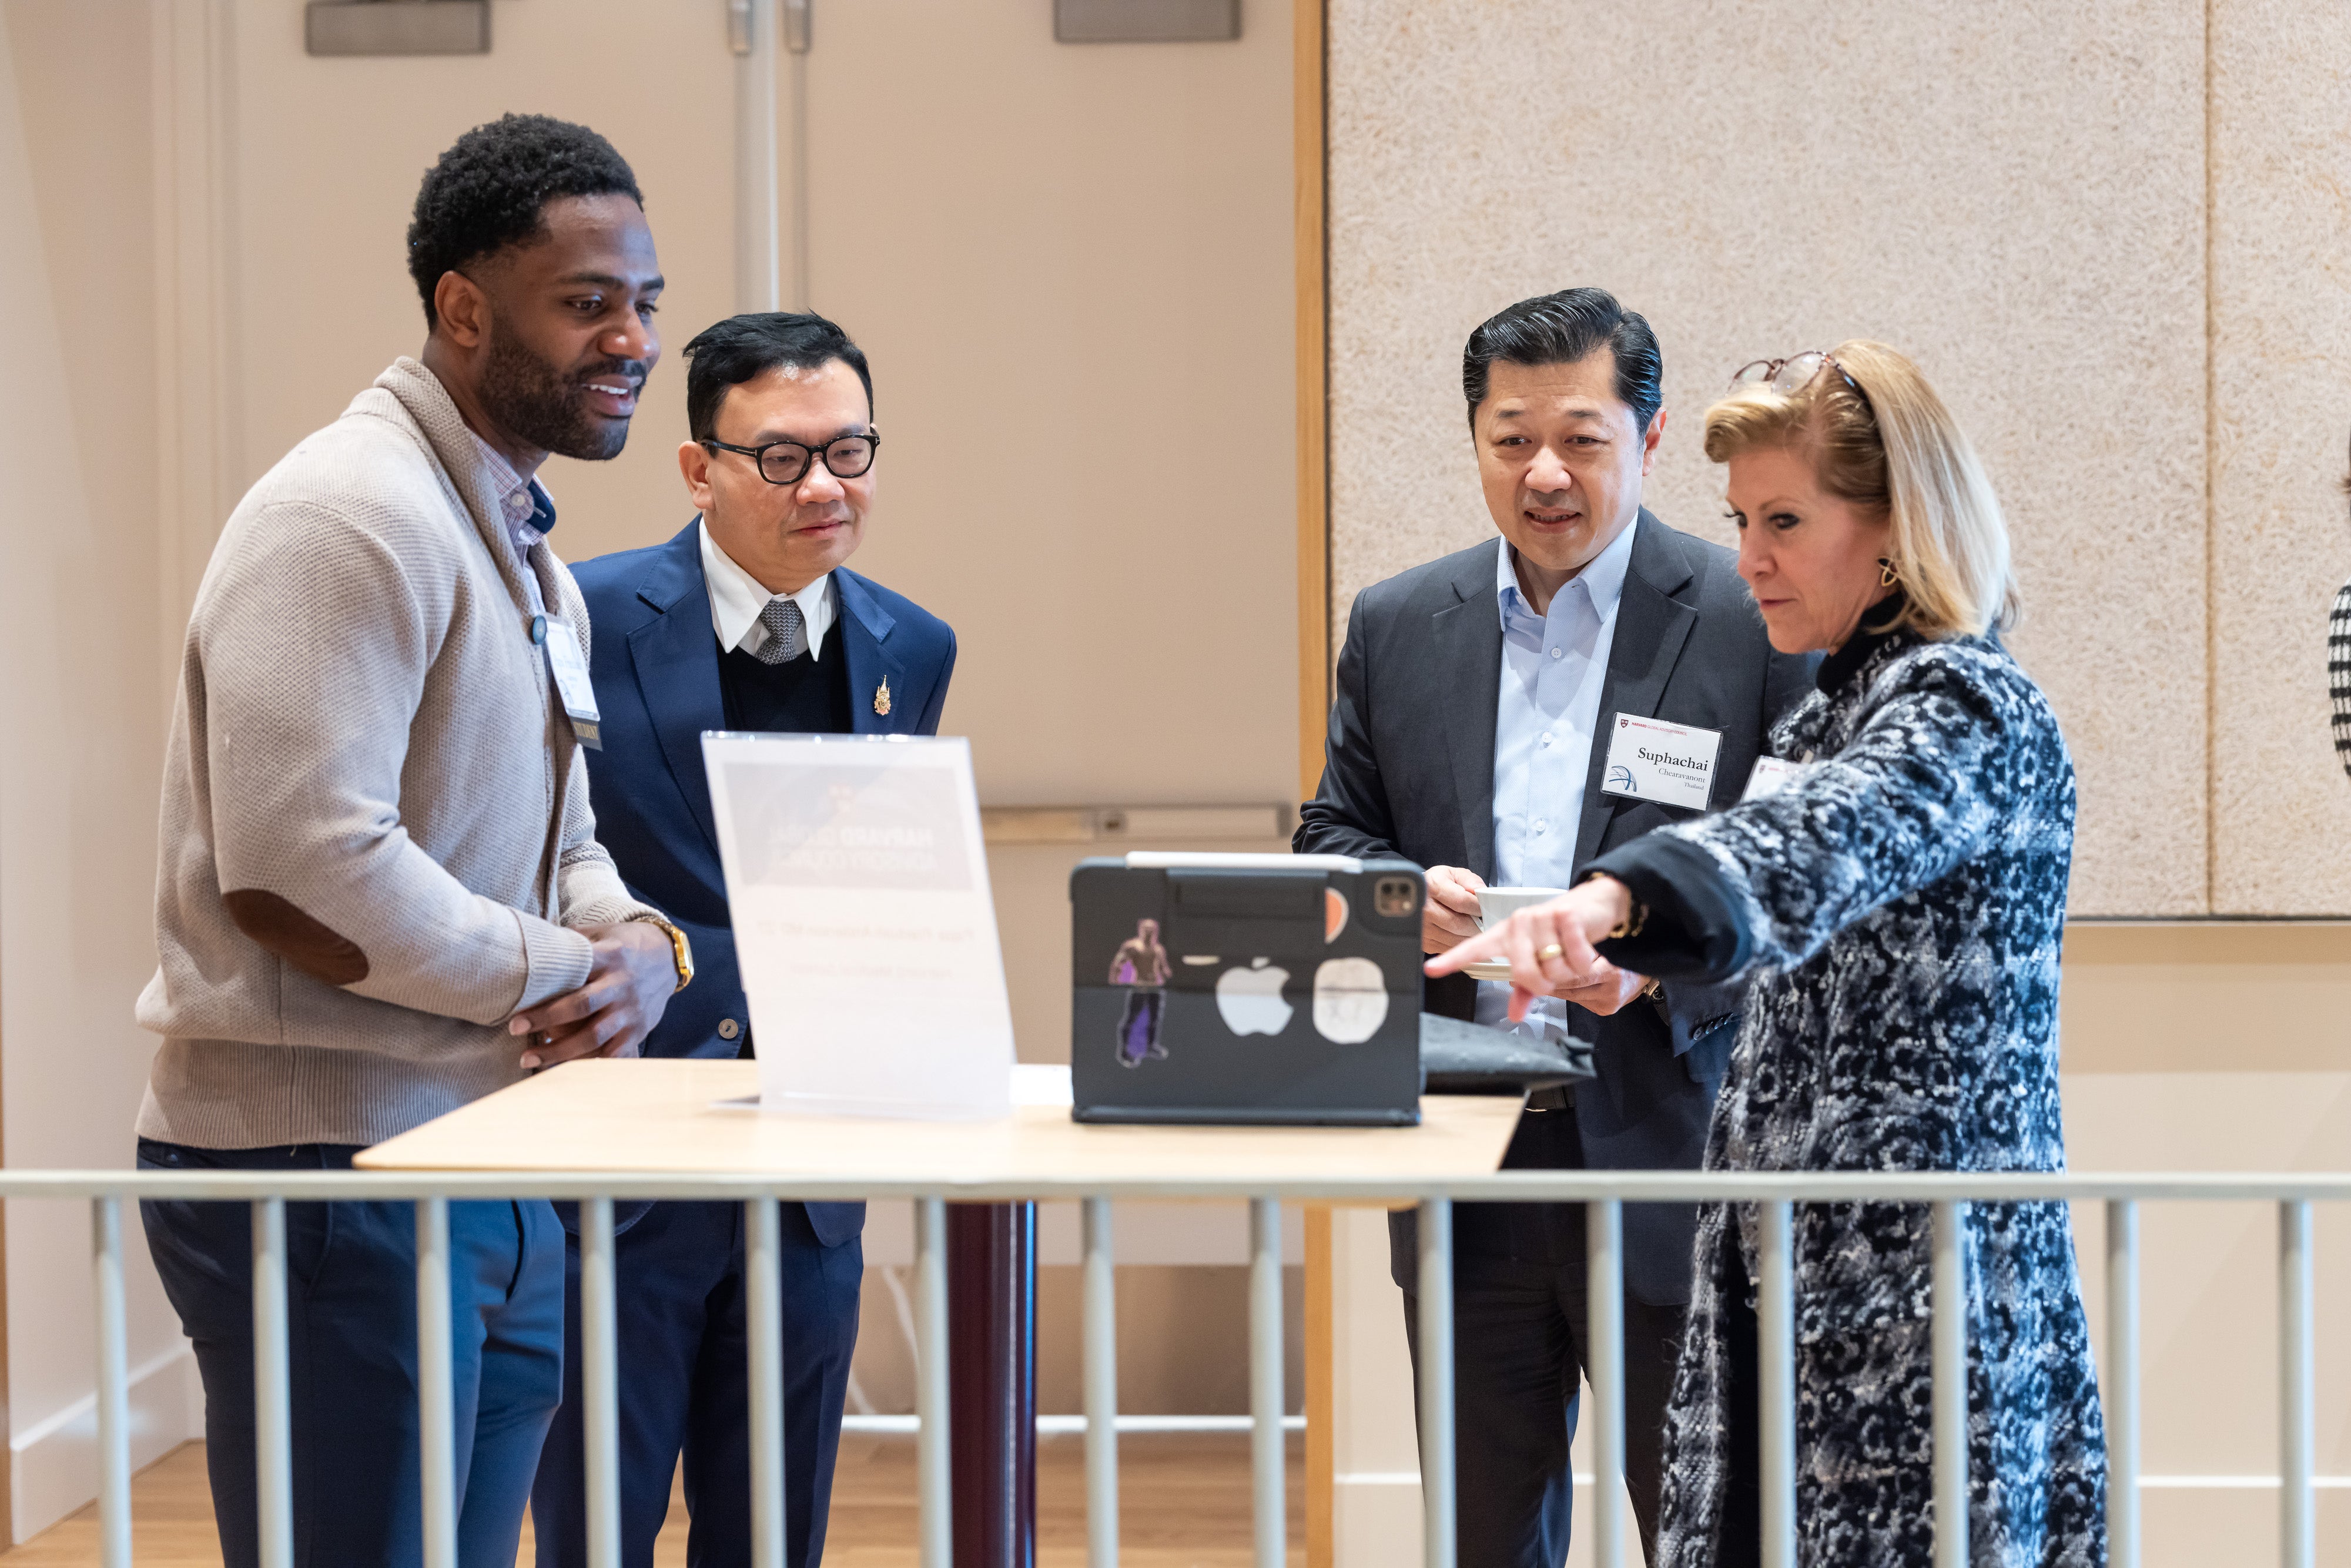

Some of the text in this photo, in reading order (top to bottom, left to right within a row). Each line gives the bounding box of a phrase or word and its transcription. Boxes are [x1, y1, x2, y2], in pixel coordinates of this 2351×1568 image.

[1637, 748, 1709, 772] Suphachai
[1659, 768, 1706, 783] Chearavanont
[1684, 782, 1704, 790] Thailand
